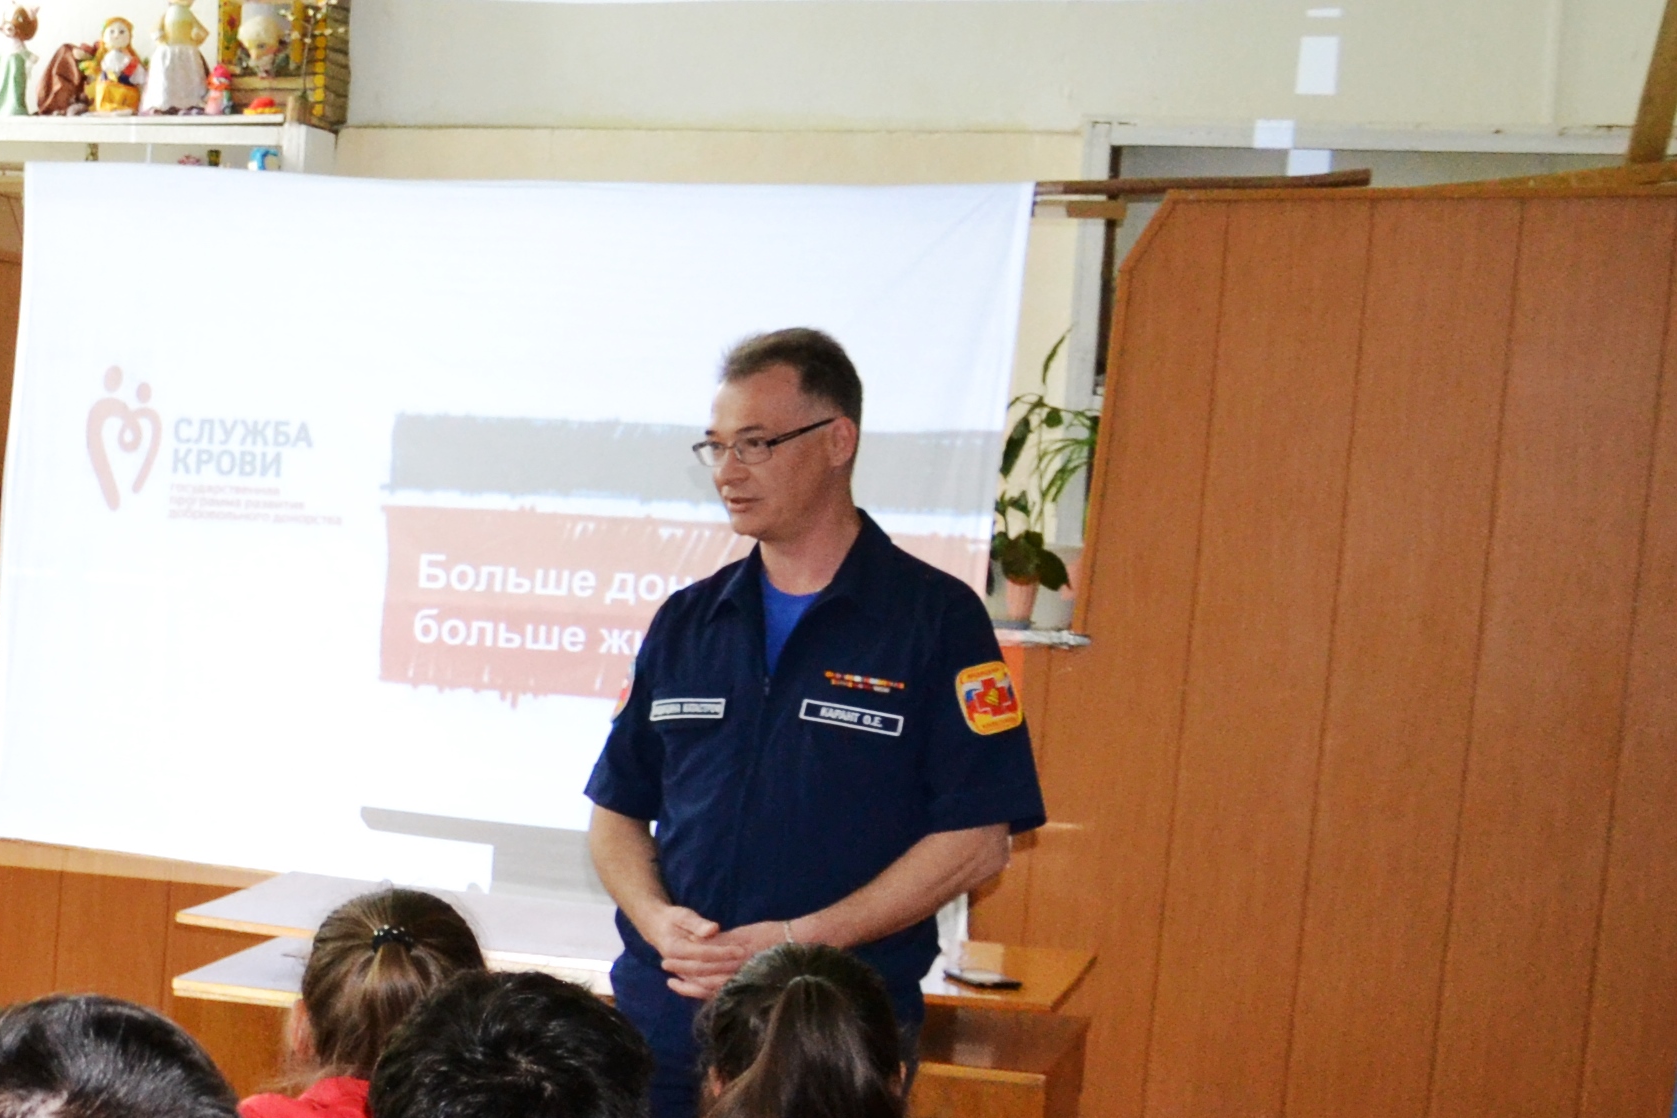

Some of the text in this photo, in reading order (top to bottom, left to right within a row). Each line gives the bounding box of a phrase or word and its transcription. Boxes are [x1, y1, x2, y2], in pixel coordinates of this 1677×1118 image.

[174, 418, 313, 448] СЛУЖБА
[172, 448, 282, 478] КРОВИ
[418, 553, 596, 597] Больше
[414, 609, 586, 652] больше
